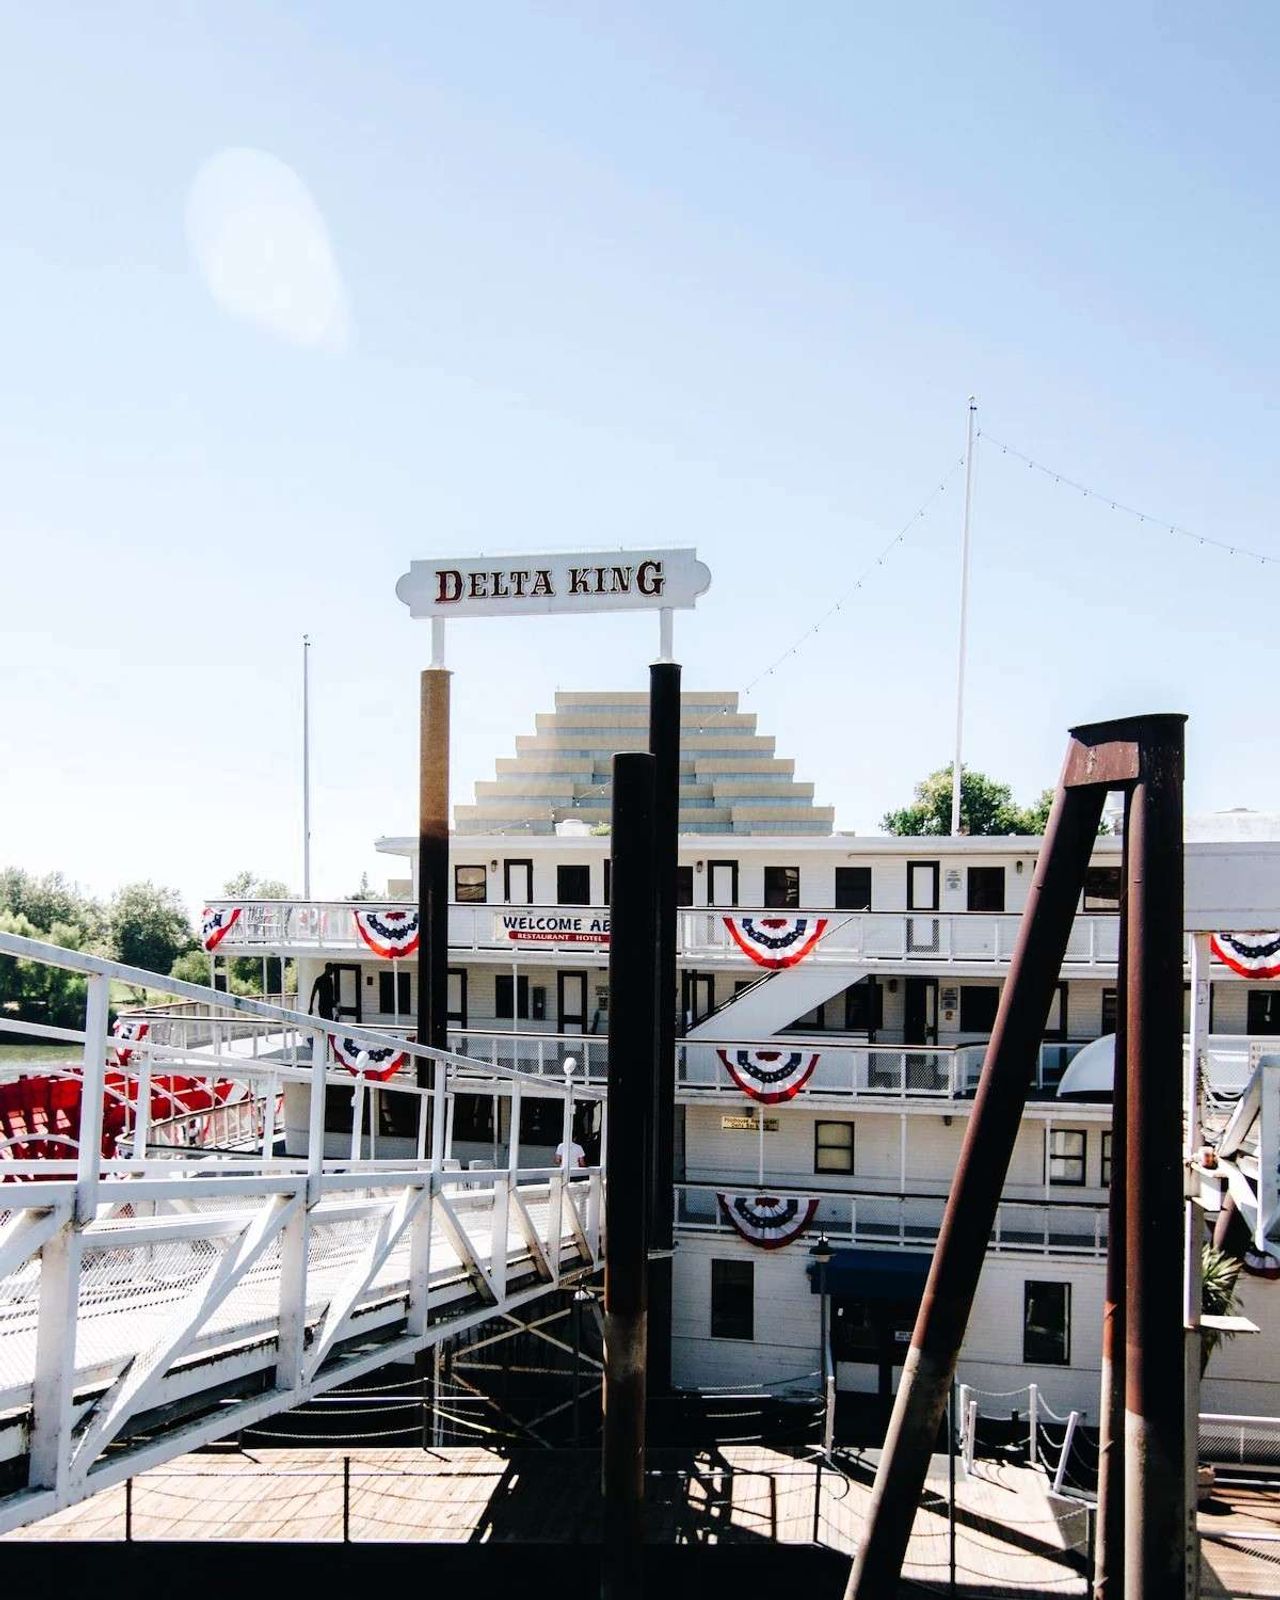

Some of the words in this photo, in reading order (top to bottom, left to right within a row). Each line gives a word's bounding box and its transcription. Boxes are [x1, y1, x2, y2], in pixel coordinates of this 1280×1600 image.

[434, 570, 555, 604] DELTA
[568, 560, 666, 597] KING
[503, 916, 582, 931] WELCOME
[517, 932, 569, 941] RESTAURANT
[575, 934, 602, 942] HOTEL
